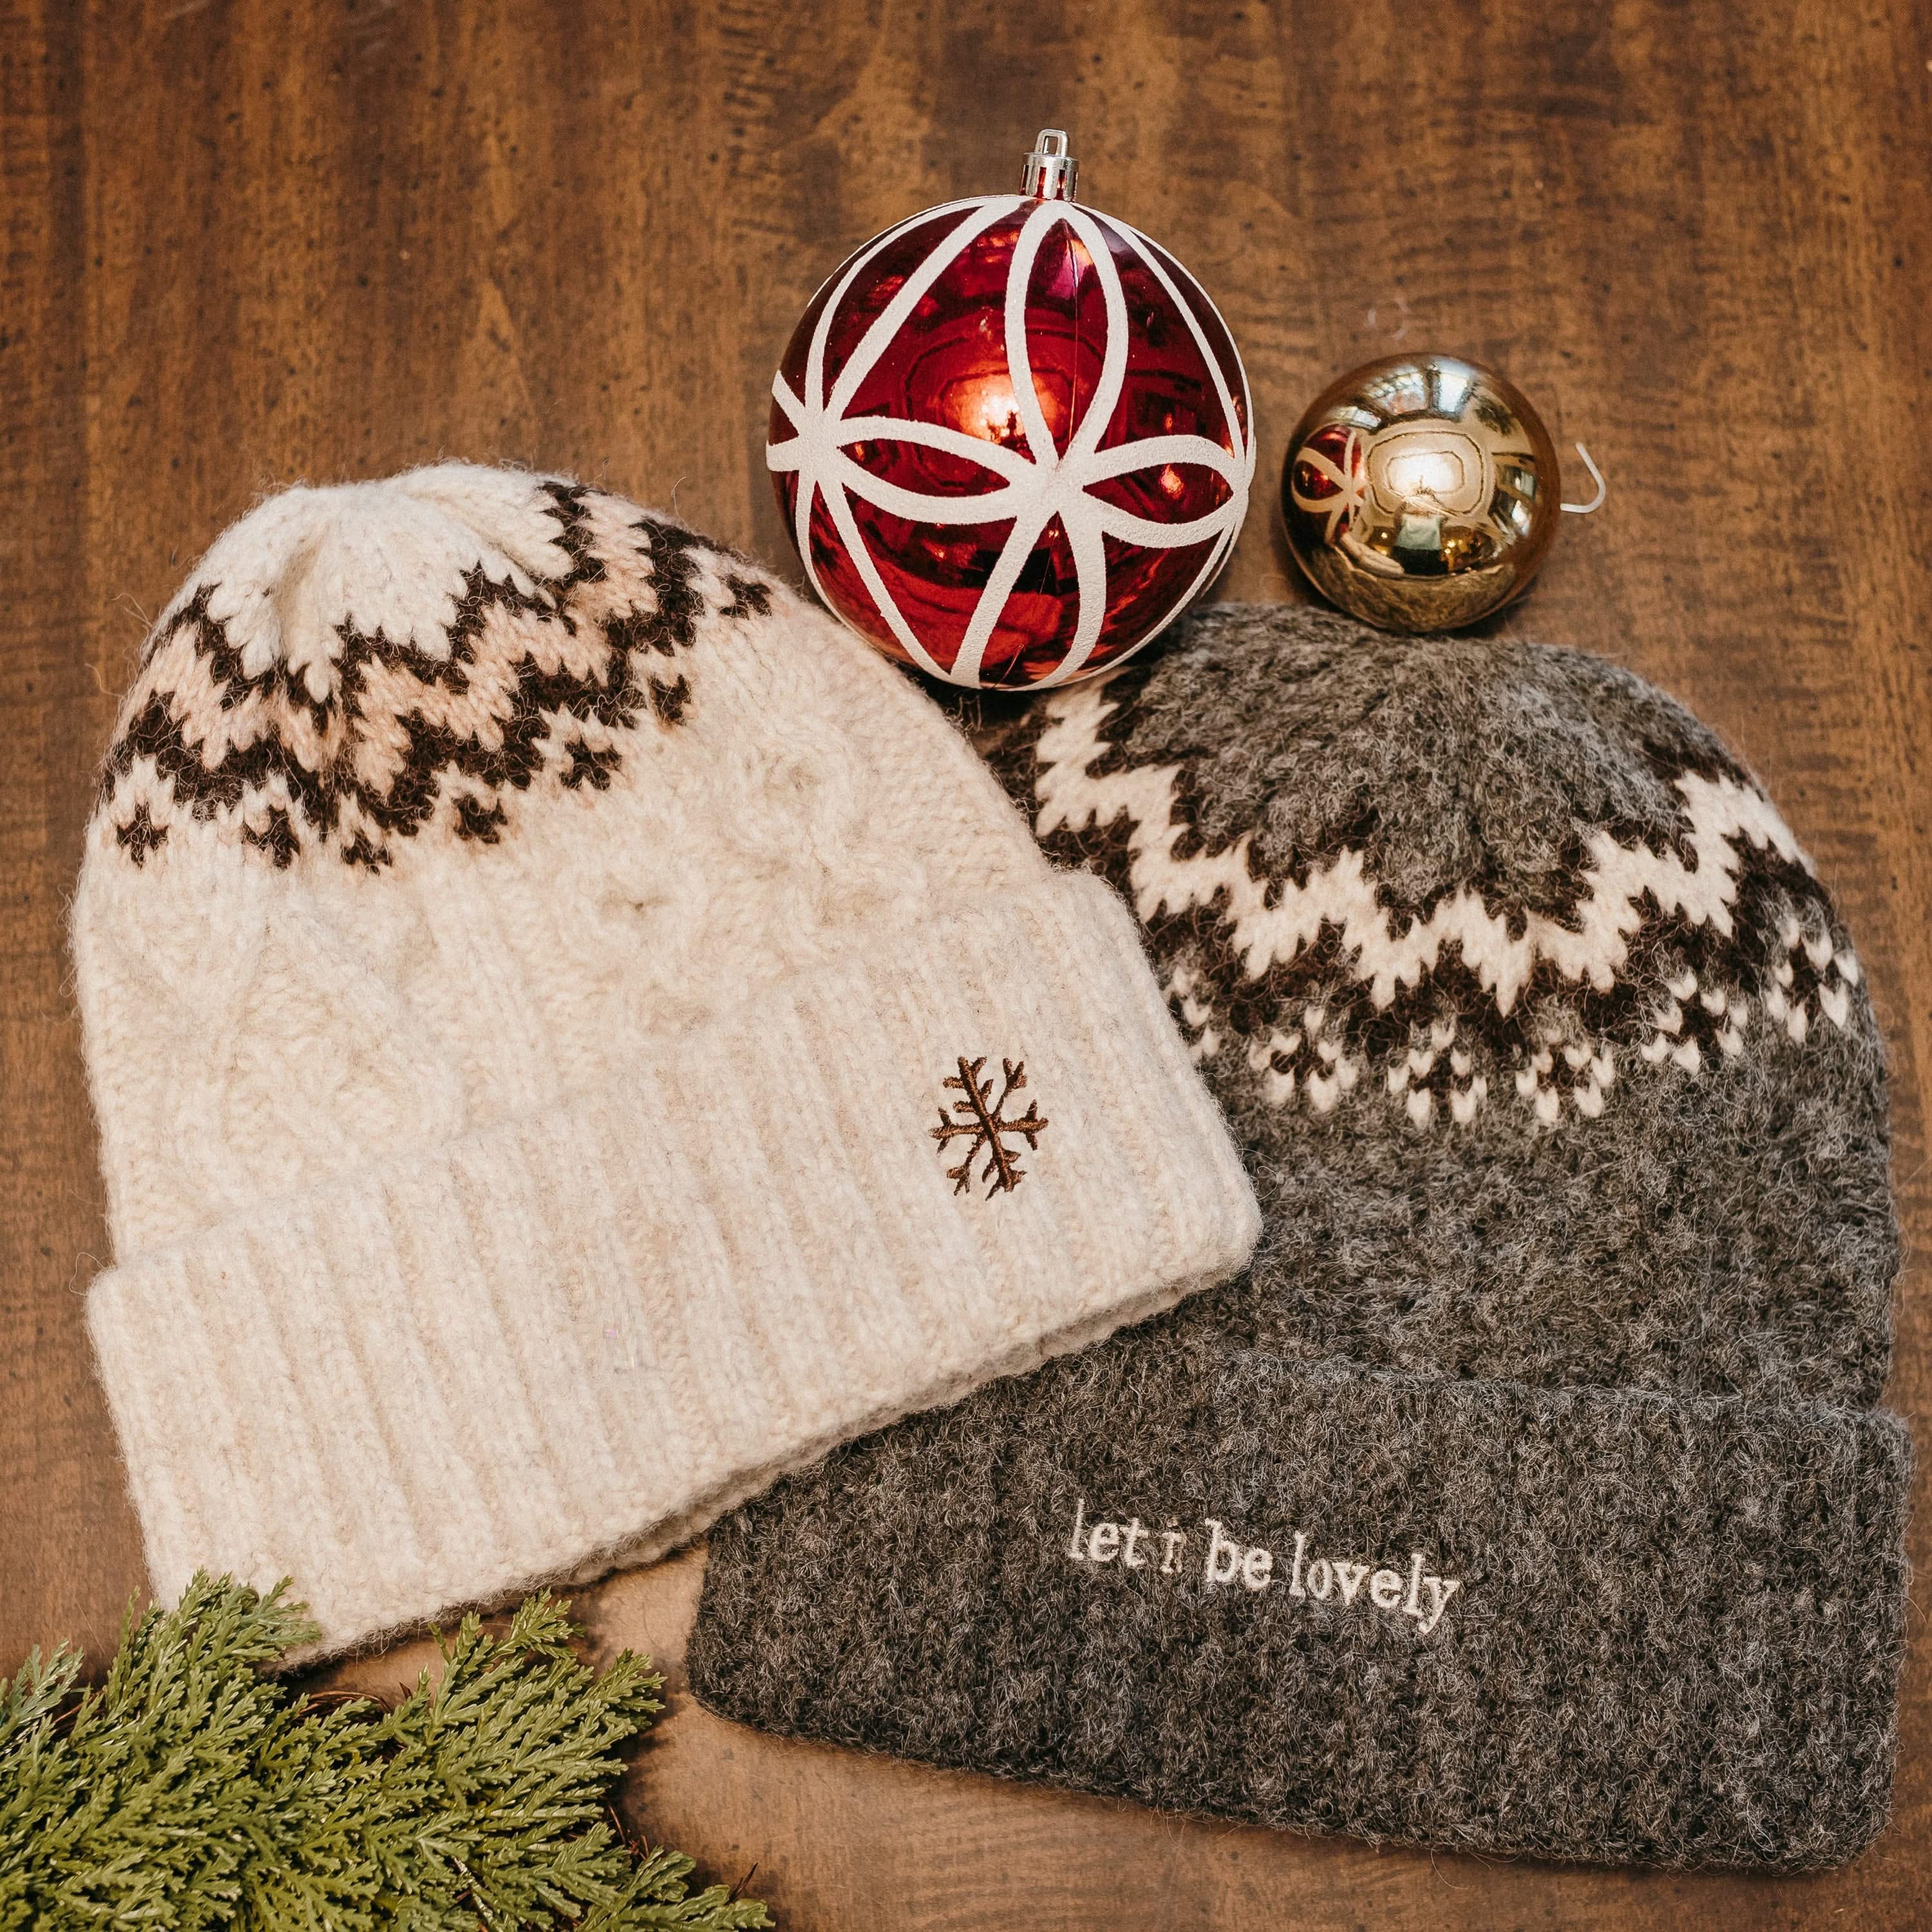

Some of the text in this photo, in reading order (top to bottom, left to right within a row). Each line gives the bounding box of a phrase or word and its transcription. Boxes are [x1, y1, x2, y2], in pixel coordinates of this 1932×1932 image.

[1067, 1498, 1148, 1567] let
[1202, 1517, 1273, 1591] be
[1289, 1530, 1461, 1634] lovely
